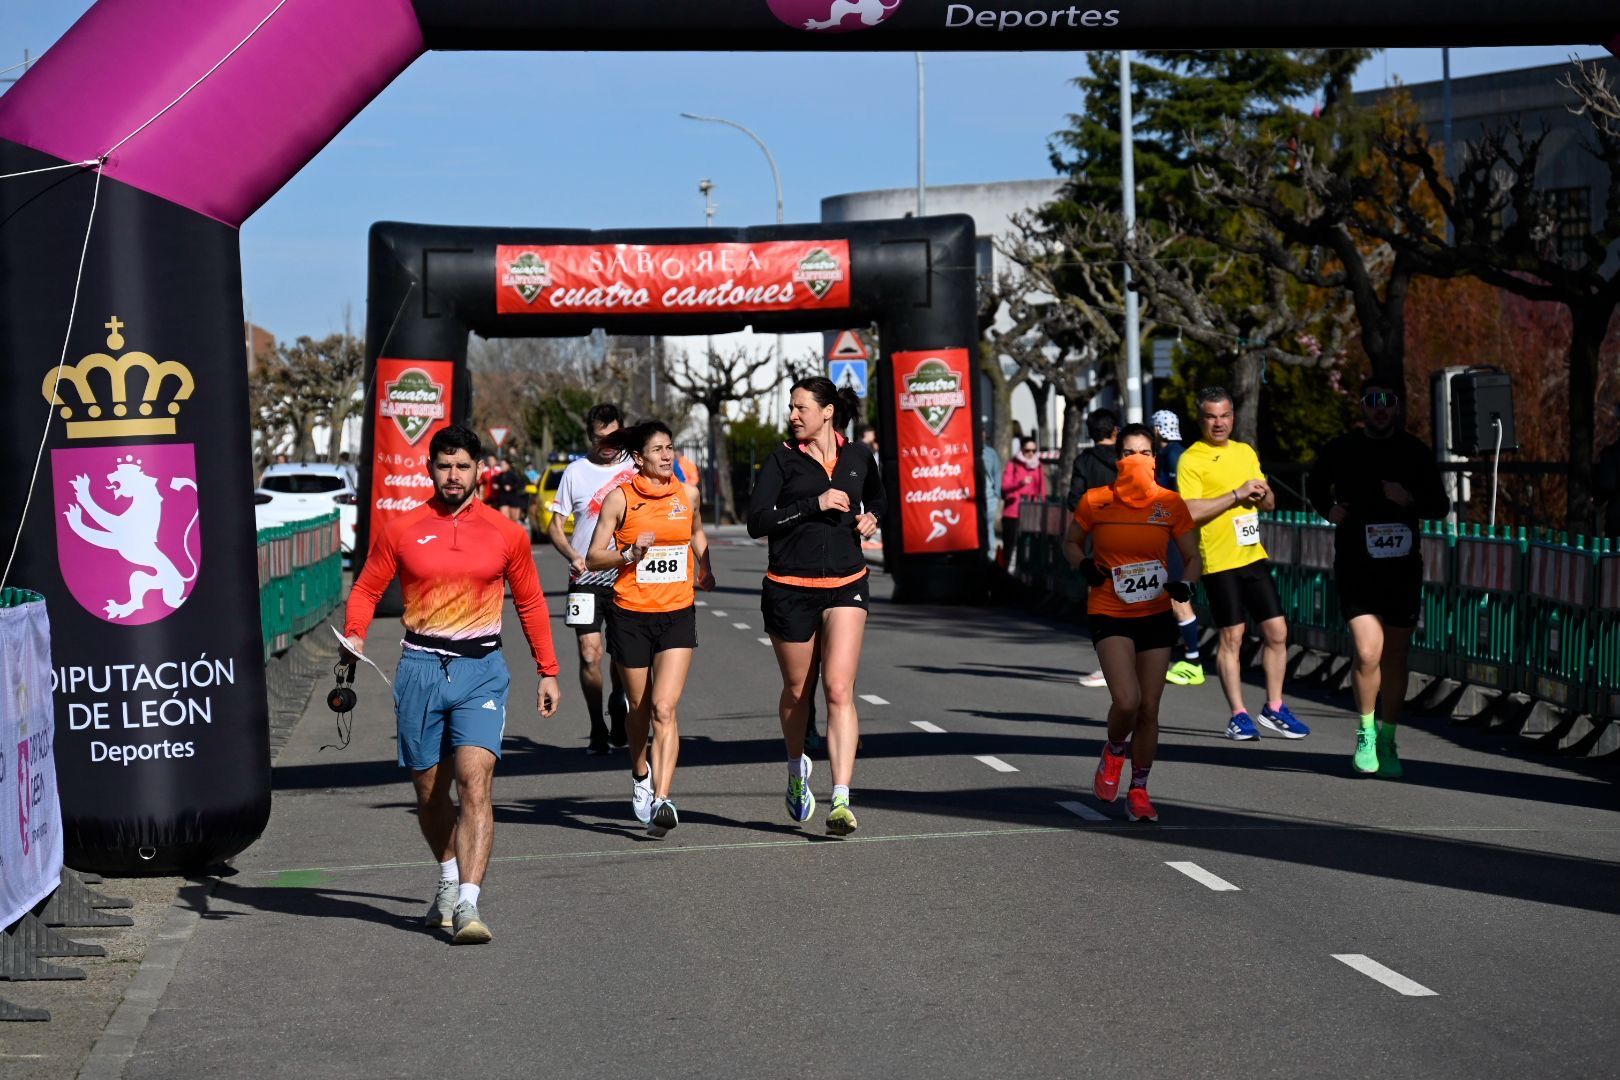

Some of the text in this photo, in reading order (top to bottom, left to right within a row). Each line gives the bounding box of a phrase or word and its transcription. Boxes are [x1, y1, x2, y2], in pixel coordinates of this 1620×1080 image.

[945, 4, 1120, 31] Deportes
[549, 279, 795, 307] cuatro cantones
[908, 378, 957, 392] cuatro
[389, 389, 437, 402] cuatro
[377, 452, 430, 468] SABOR
[911, 461, 961, 479] cuatro
[905, 486, 970, 503] cantones
[376, 496, 424, 511] canto
[1374, 535, 1404, 548] 447
[645, 559, 678, 573] 488
[1124, 574, 1159, 593] 244
[68, 690, 212, 730] DE LEÓN
[90, 739, 195, 767] Deportes
